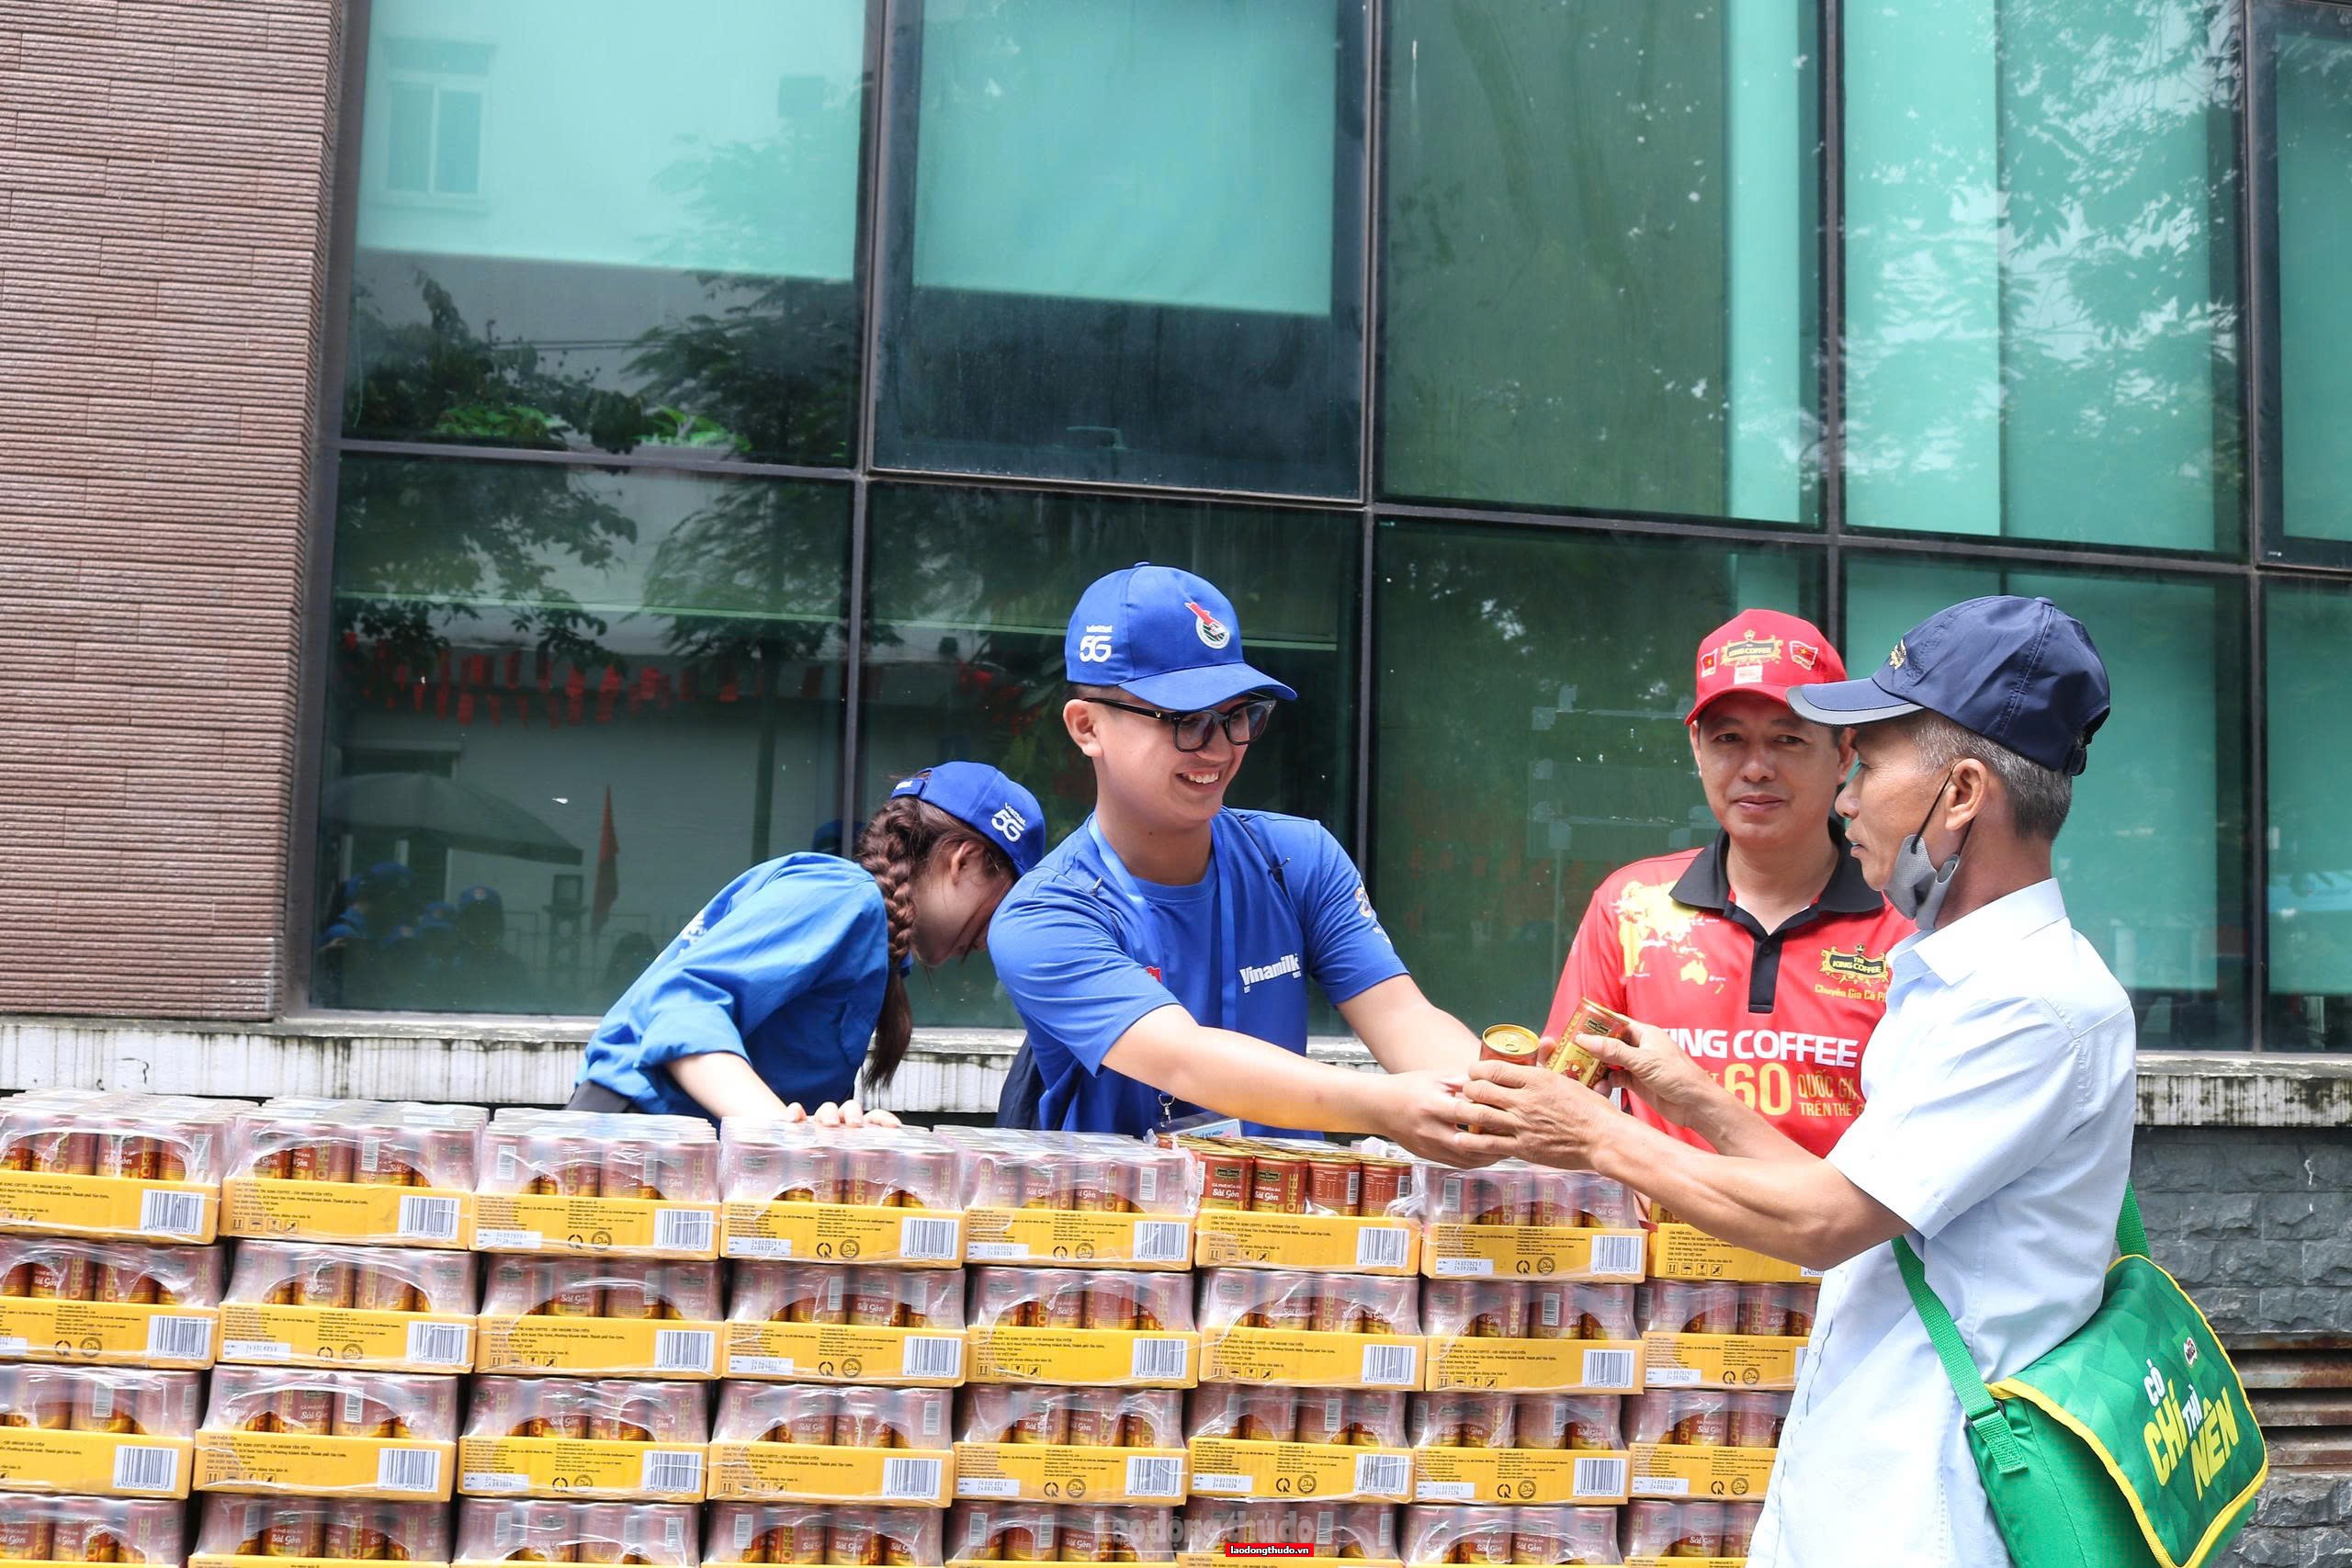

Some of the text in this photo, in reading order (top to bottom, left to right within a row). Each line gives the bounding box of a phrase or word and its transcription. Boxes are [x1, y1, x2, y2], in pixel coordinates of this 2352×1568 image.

[1080, 635, 1113, 662] 5G
[991, 808, 1024, 842] 5G
[1239, 953, 1299, 986] Vinamilk
[1833, 960, 1883, 975] KING COFFEE
[1848, 988, 1861, 1000] Gia
[1662, 1028, 1860, 1068] ING COFFEE
[1724, 1062, 1792, 1117] 60
[1796, 1068, 1834, 1099] QUỐC
[1800, 1100, 1832, 1118] TRÊN
[1212, 1188, 1240, 1199] Sài Gòn
[1254, 1190, 1280, 1201] Sài Gòn
[1286, 1172, 1299, 1214] OFFEE
[868, 1303, 885, 1314] Gòn
[1509, 1295, 1521, 1338] OFFEE
[2143, 1358, 2165, 1407] CÓ
[2143, 1378, 2203, 1486] CHÍ THÌ
[2190, 1386, 2239, 1502] NÊN
[271, 1533, 285, 1543] Sài
[1516, 1542, 1543, 1553] Sài Gòn
